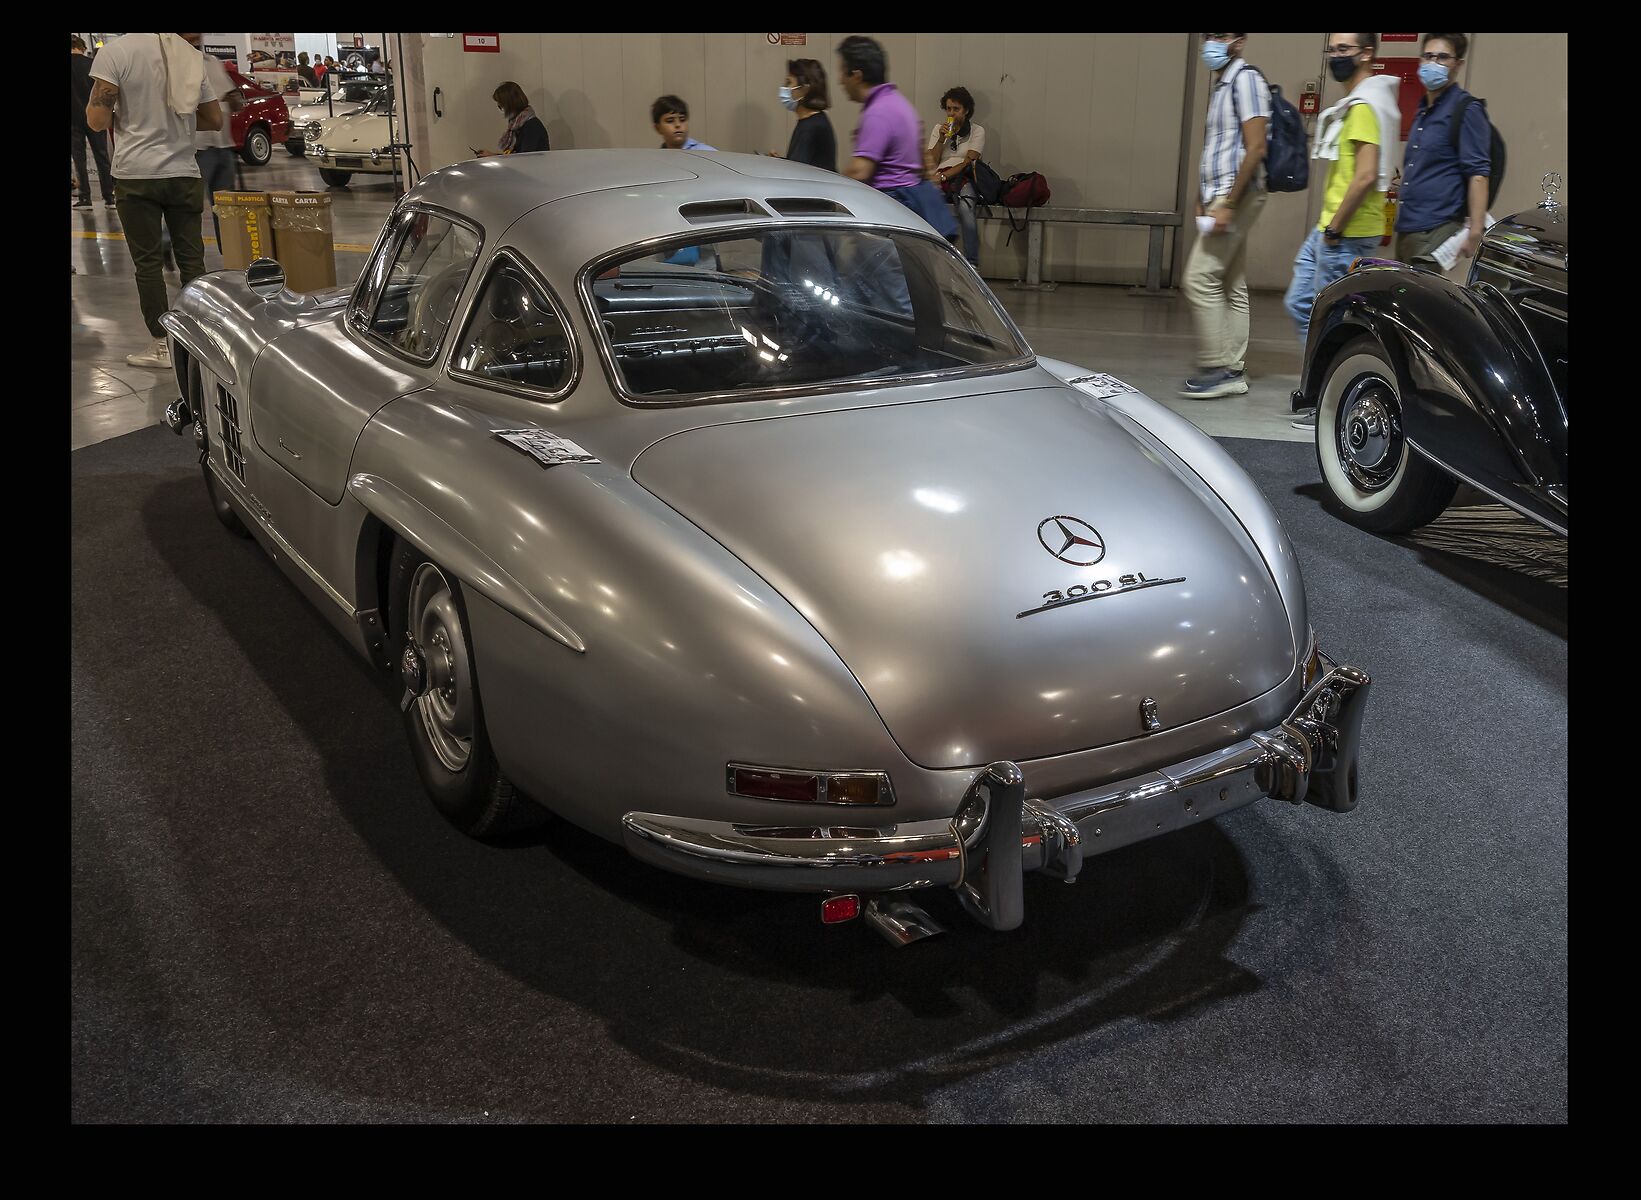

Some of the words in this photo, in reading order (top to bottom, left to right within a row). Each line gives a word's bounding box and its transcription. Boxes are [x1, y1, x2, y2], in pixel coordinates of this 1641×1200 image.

[272, 196, 289, 205] CARTA
[1042, 580, 1113, 607] 300
[1118, 572, 1164, 588] SL
